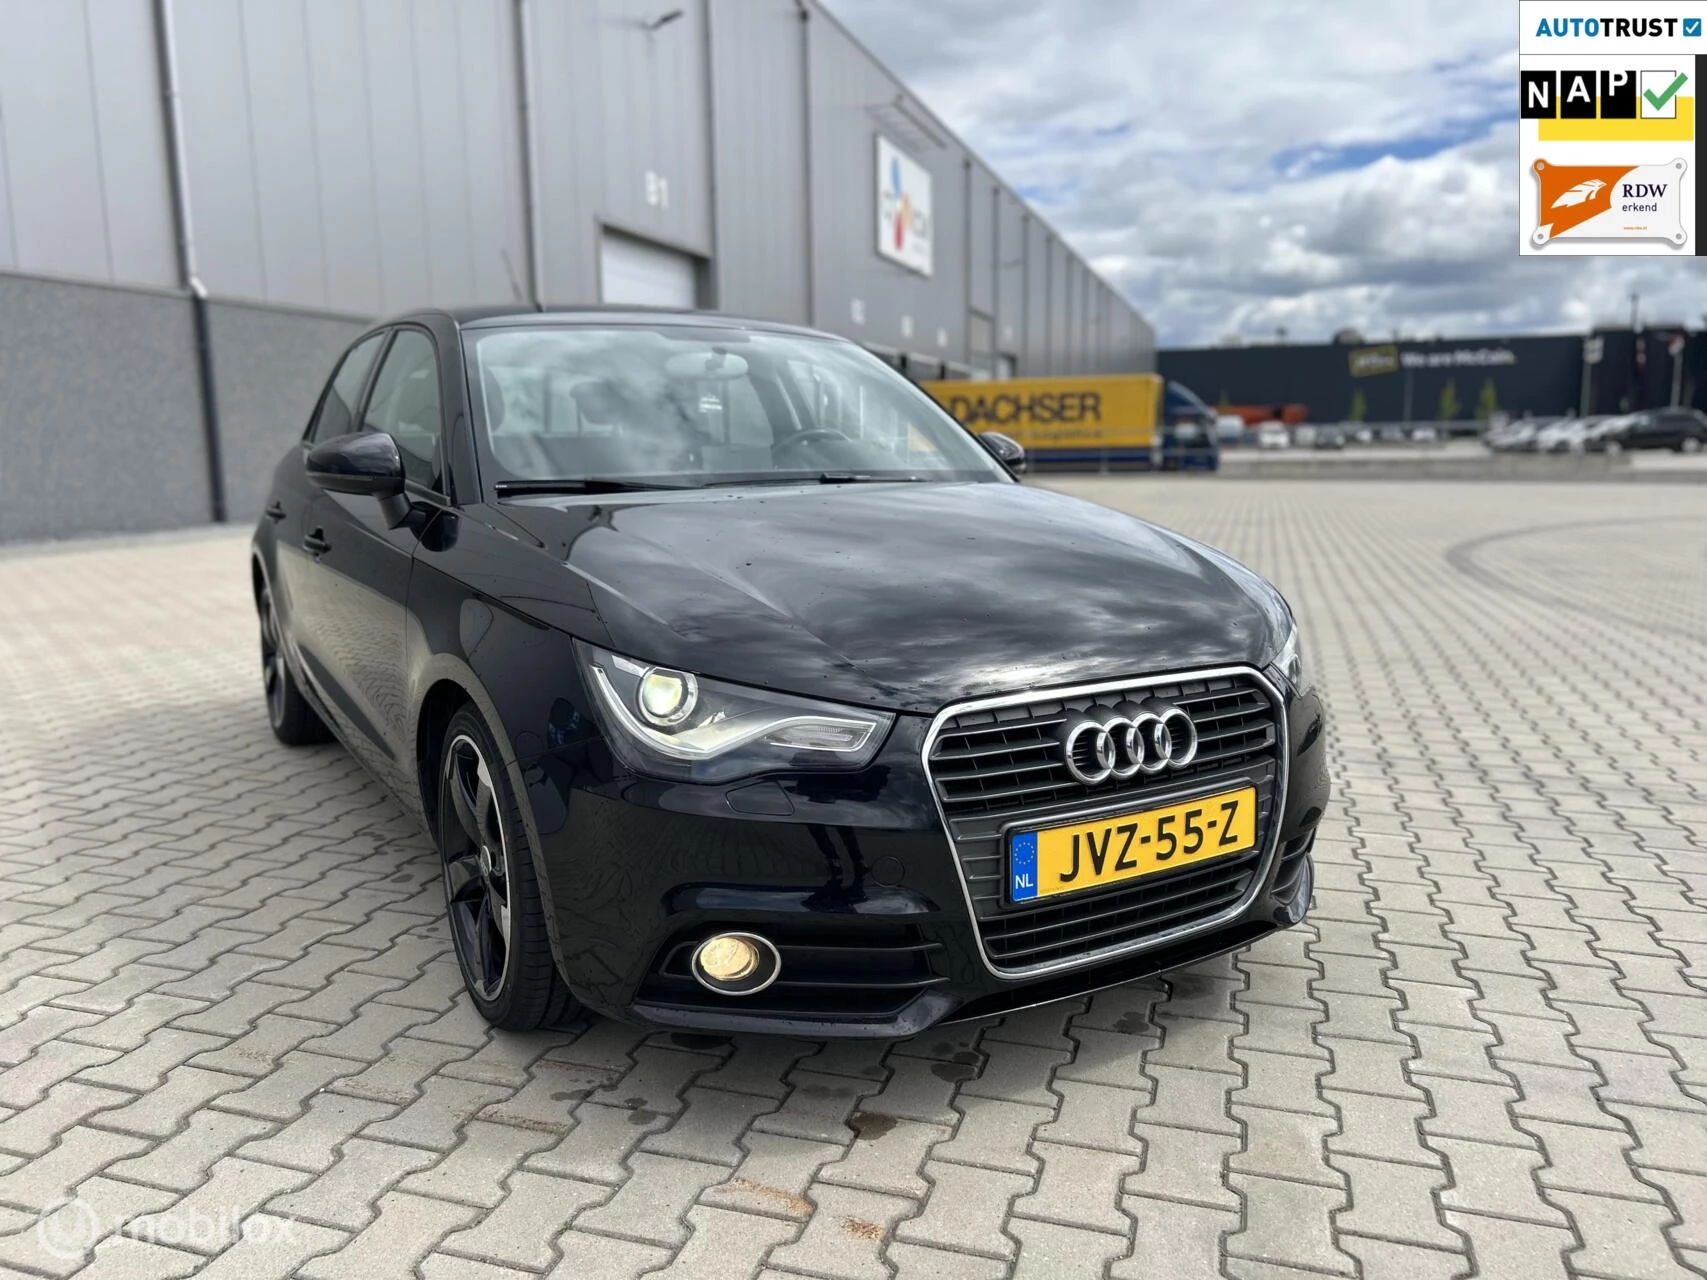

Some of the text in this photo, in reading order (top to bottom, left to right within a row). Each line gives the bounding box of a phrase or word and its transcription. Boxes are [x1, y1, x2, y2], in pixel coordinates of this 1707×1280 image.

[951, 392, 1103, 425] DACHSER
[1059, 799, 1240, 883] JVZ-55-Z
[1014, 874, 1034, 889] NL
